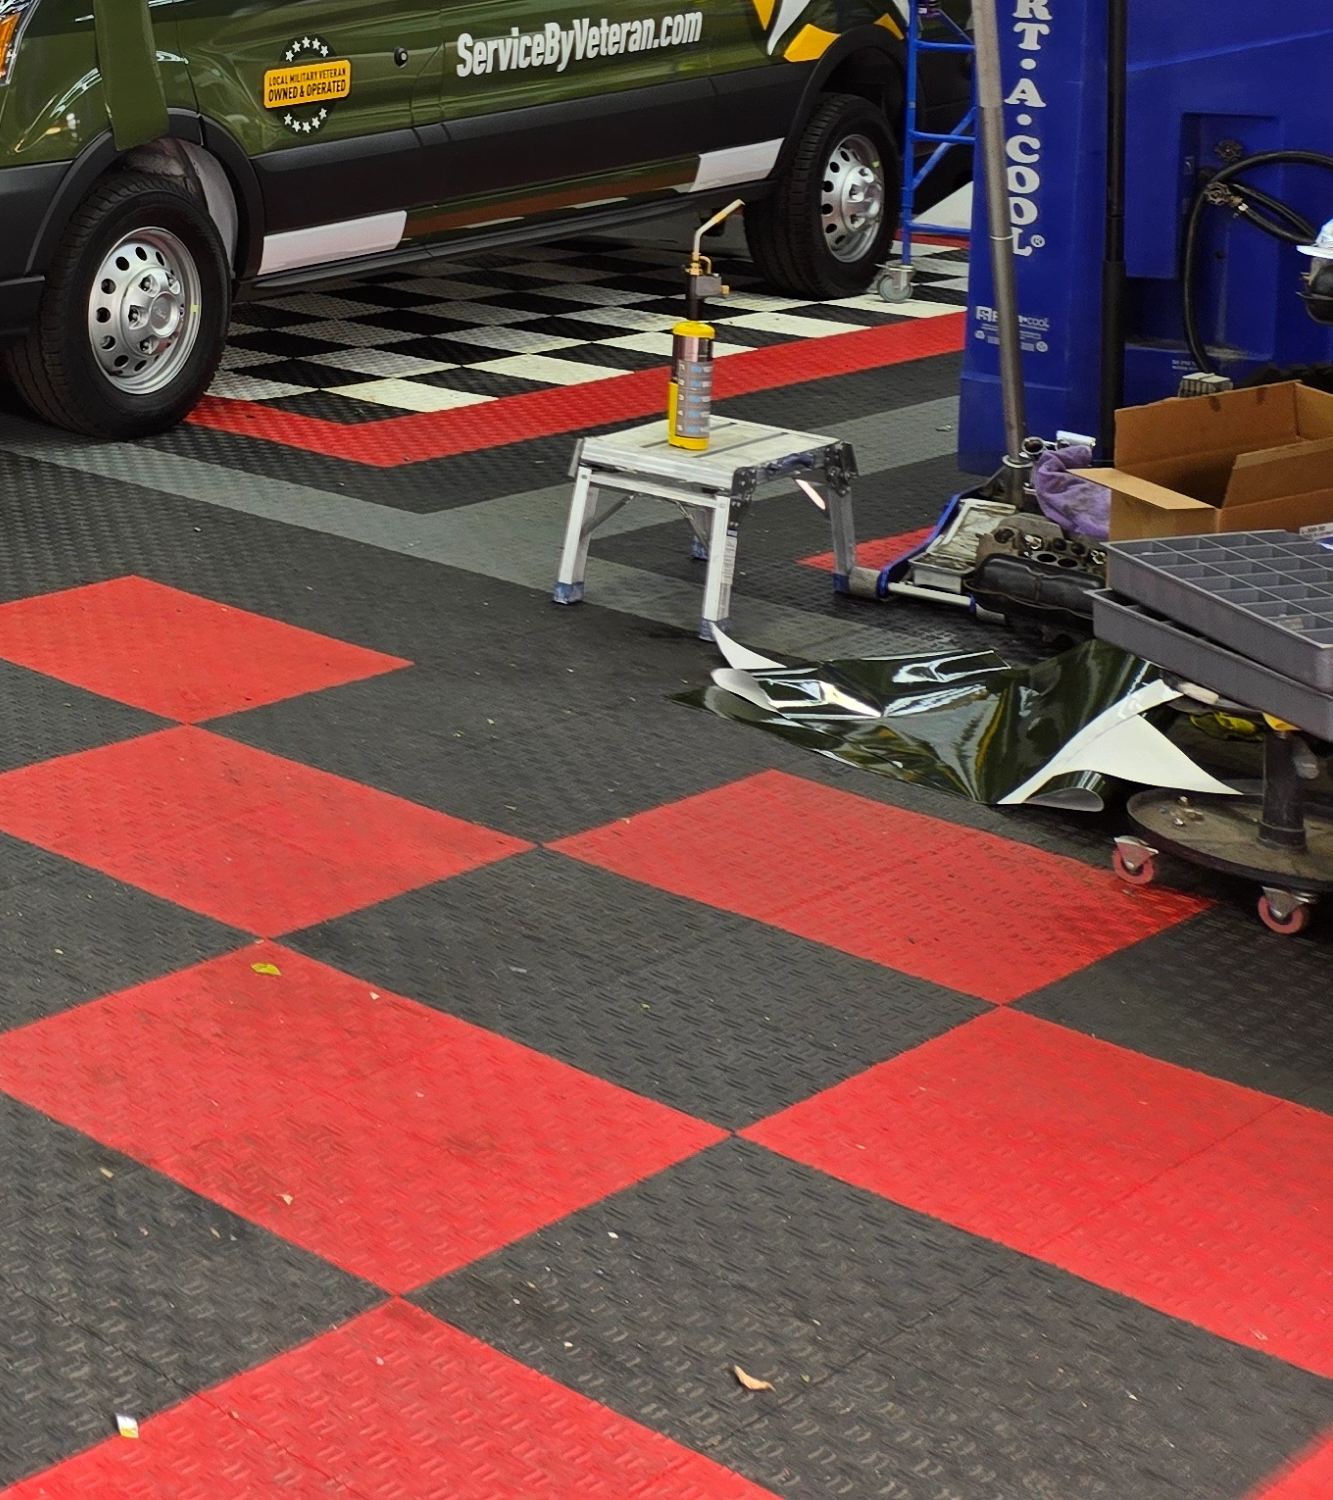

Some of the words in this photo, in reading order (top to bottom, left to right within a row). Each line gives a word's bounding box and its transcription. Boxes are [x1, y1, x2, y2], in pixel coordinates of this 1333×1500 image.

[456, 11, 703, 78] ServiceByVeteran.com
[269, 76, 288, 87] LOCAL
[289, 71, 319, 83] MILITARY
[319, 67, 346, 80] VETERAN
[268, 85, 298, 102] OWNED
[299, 86, 305, 97] &
[306, 79, 346, 97] OPERATED
